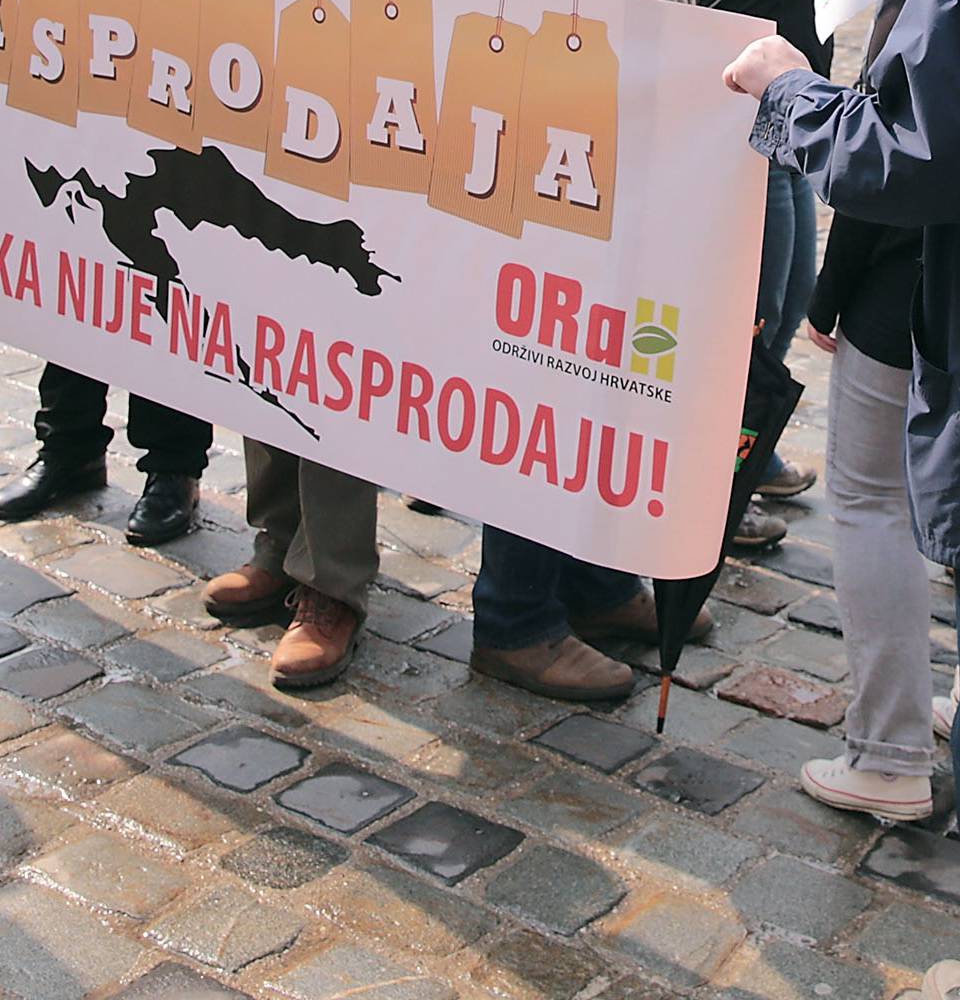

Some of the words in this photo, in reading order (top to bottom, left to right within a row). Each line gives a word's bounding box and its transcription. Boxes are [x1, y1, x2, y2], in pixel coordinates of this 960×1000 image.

[57, 251, 154, 346] NIJE
[169, 286, 235, 376] NA
[253, 314, 669, 518] RASPRODAJU!
[492, 339, 544, 366] ODRŽIVI
[546, 355, 598, 382] RAZVOJ
[600, 372, 672, 404] HRVATSKE
